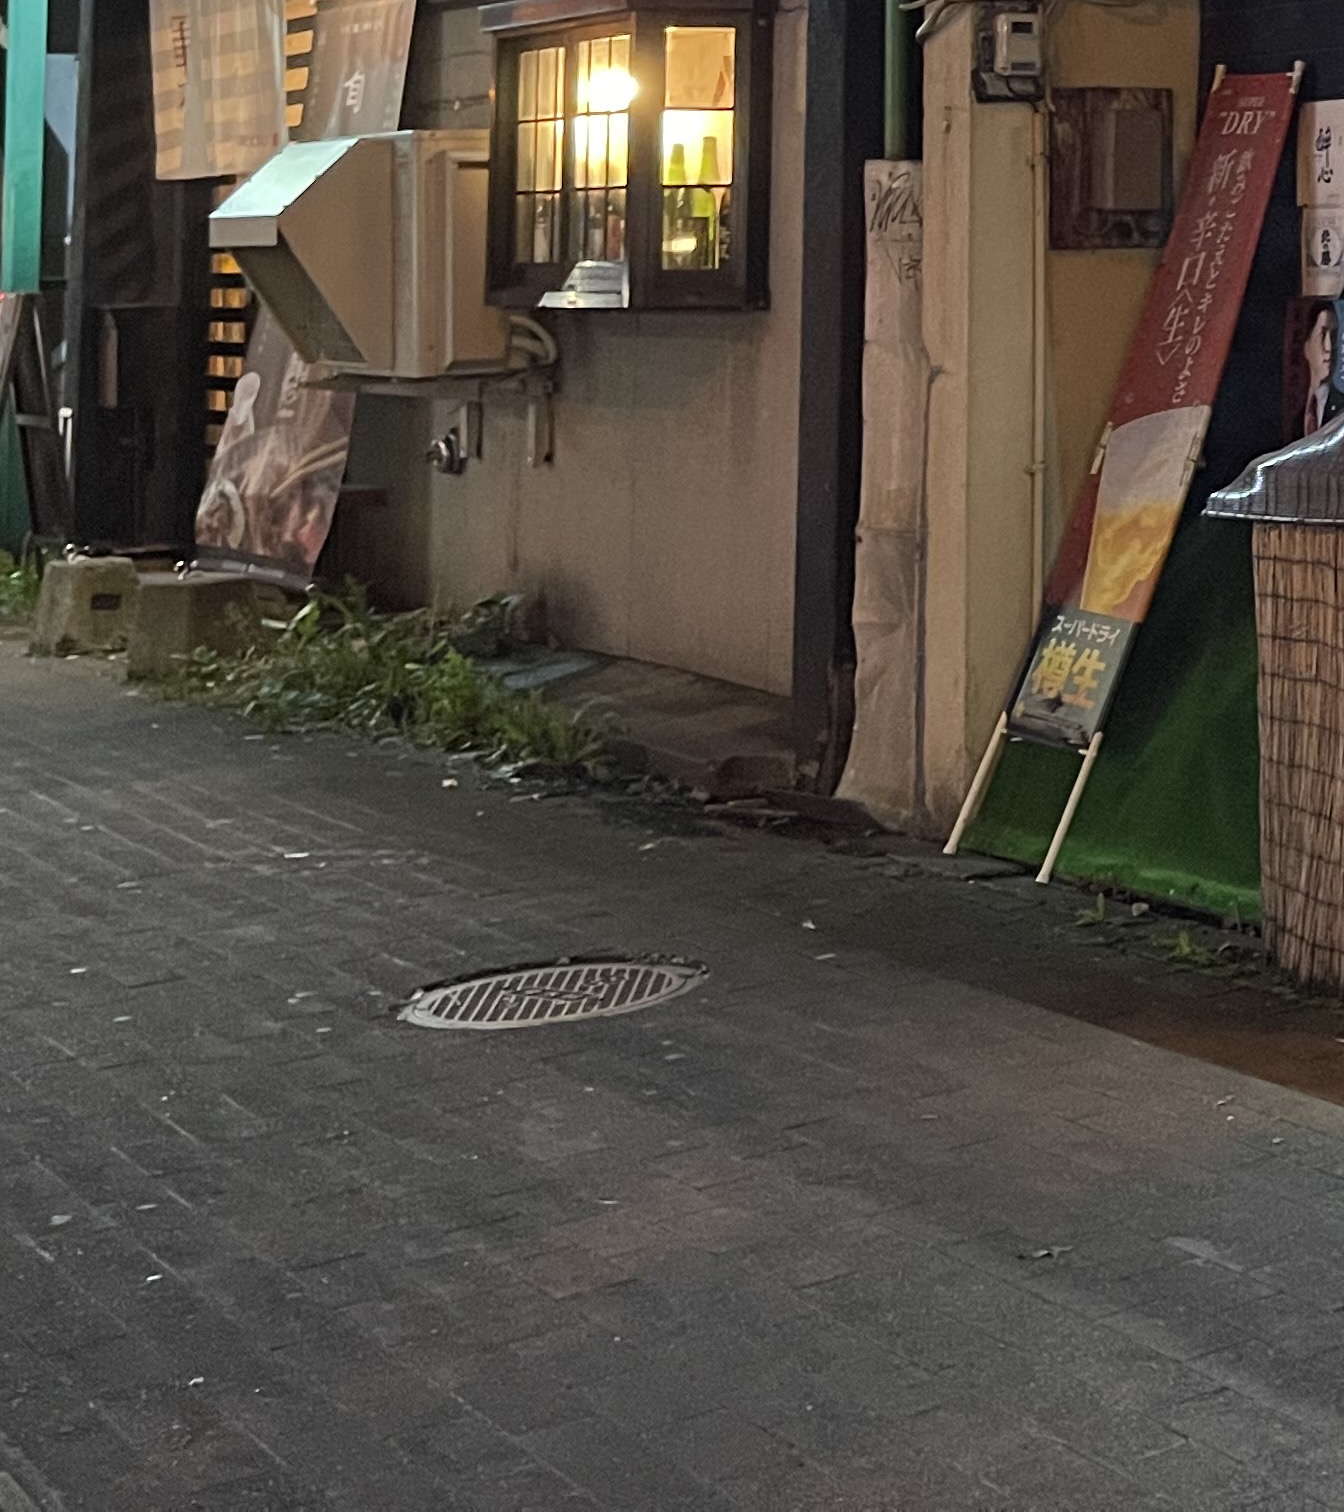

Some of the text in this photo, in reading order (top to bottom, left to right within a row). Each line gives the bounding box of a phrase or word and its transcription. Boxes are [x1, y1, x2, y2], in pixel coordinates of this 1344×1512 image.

[1052, 615, 1120, 646] スーパードライ
[1032, 638, 1106, 709] 樽生
